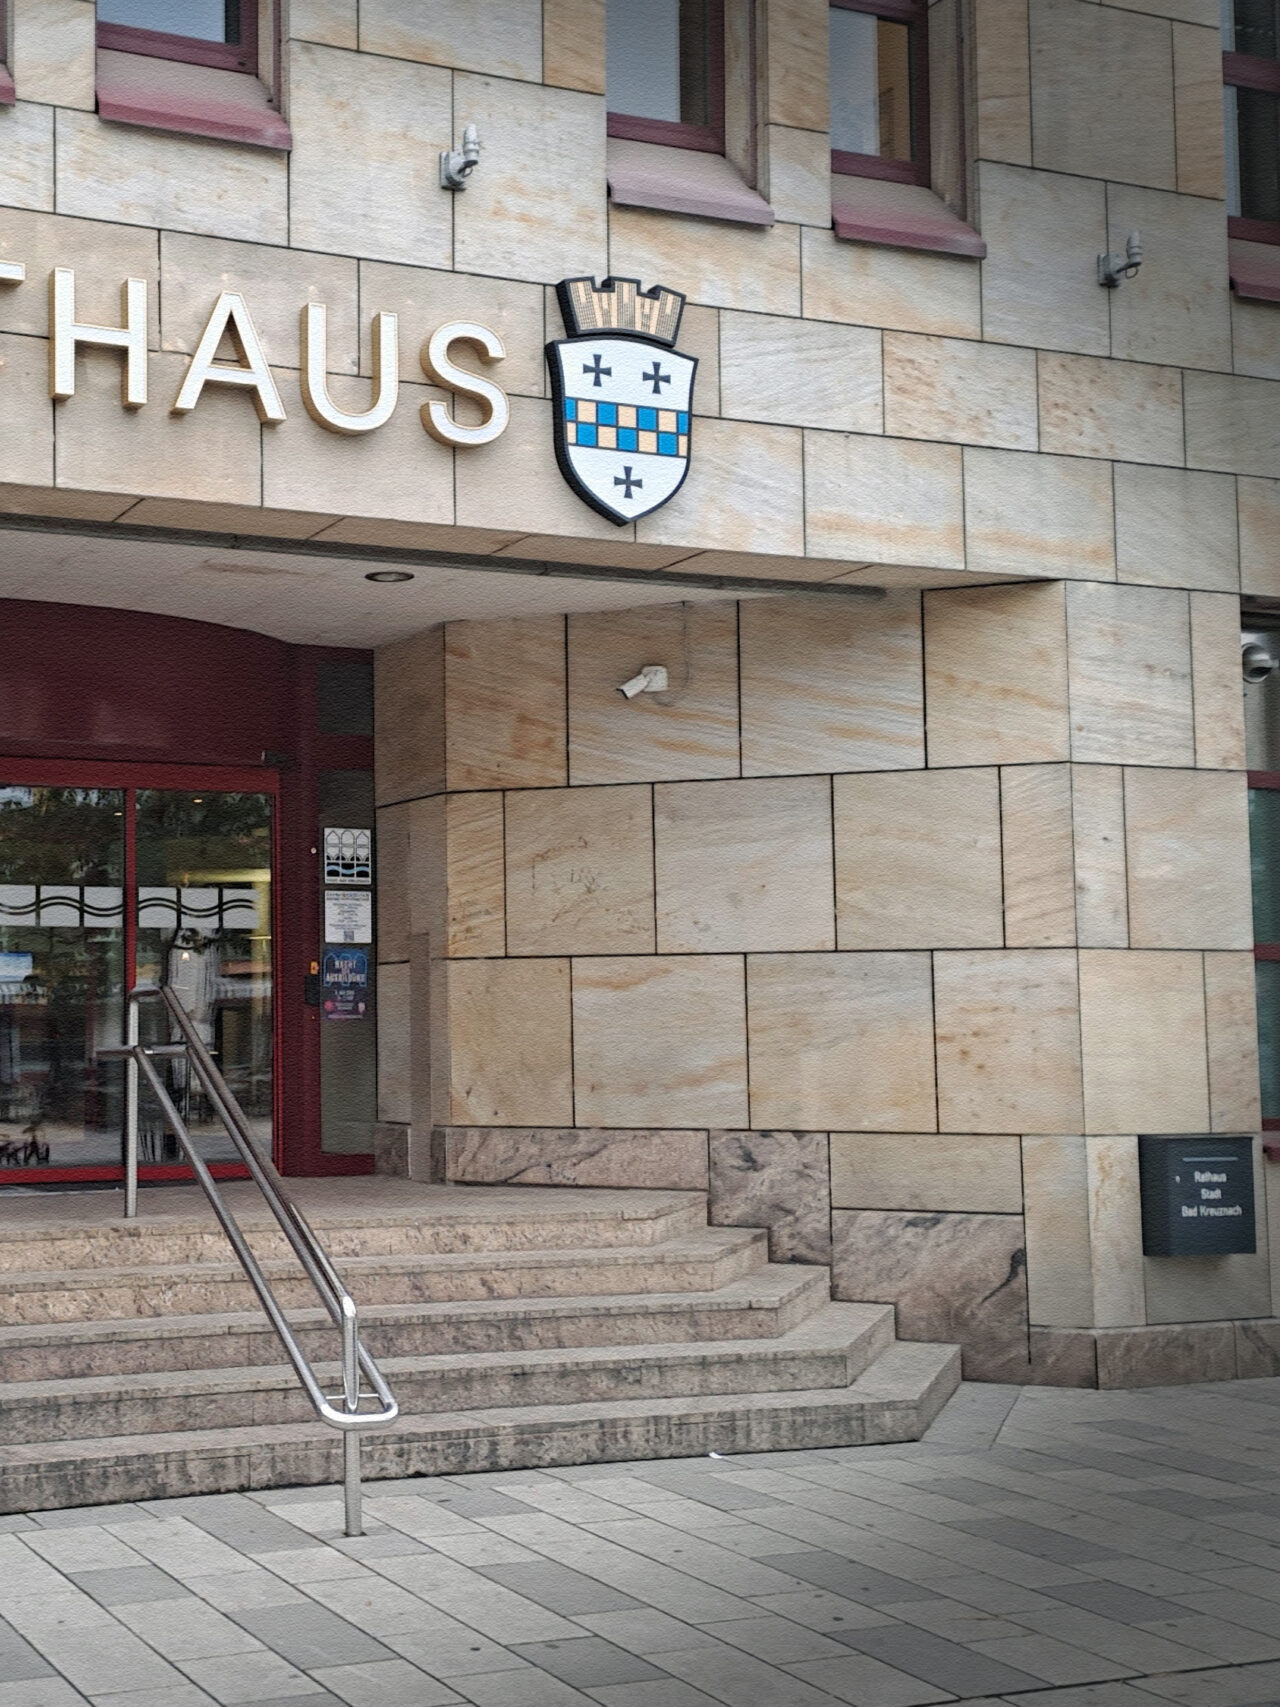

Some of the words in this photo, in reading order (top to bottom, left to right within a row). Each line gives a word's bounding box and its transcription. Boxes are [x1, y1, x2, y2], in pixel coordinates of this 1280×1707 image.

[1193, 1171, 1227, 1183] Rathaus
[1200, 1188, 1222, 1200] Stadt
[1181, 1205, 1198, 1217] Bad
[1200, 1204, 1242, 1217] Kreuznach
